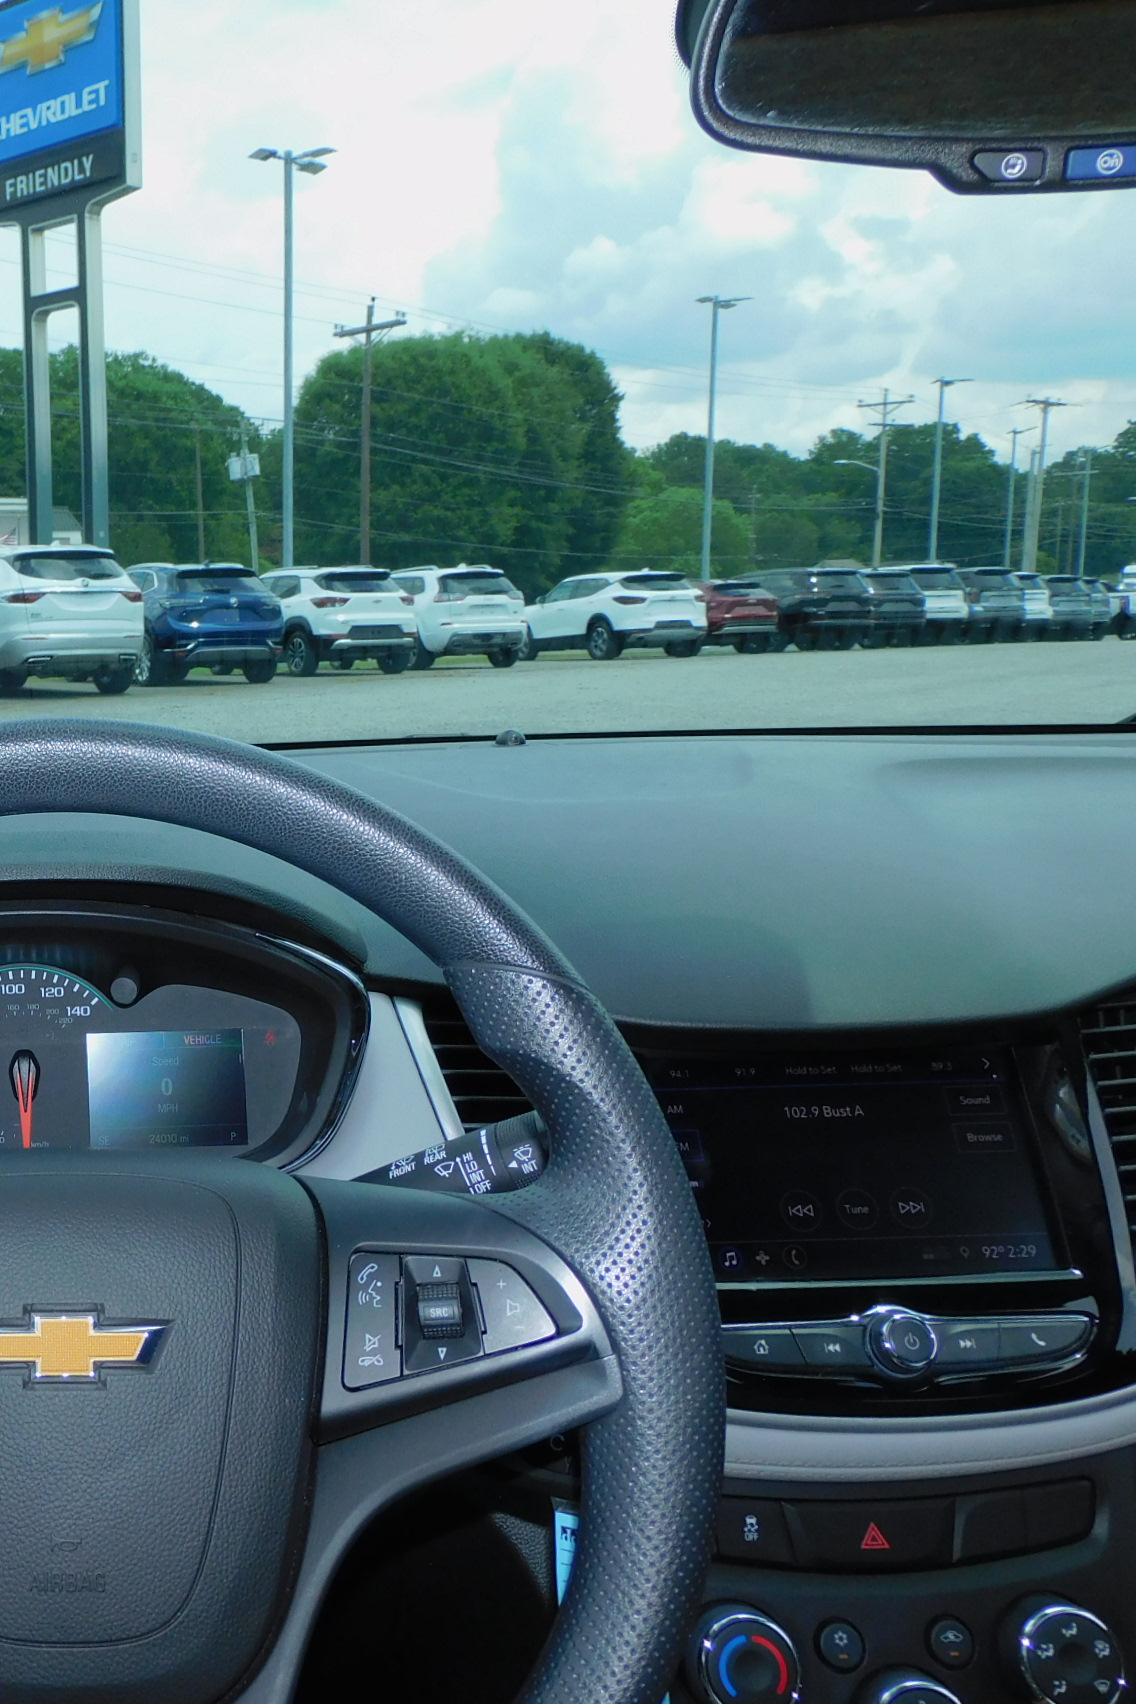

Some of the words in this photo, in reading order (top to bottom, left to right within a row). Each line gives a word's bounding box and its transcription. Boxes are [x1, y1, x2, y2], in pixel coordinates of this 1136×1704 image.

[5, 154, 94, 201] FRIENDLY
[0, 984, 25, 994] 100
[40, 987, 64, 998] 120
[66, 1006, 91, 1017] 140
[183, 1034, 222, 1046] VEHICLE
[152, 1056, 179, 1067] Speed
[785, 1066, 807, 1076] Hold
[809, 1067, 819, 1075] to
[820, 1065, 838, 1074] Set
[850, 1064, 872, 1073] Hold
[874, 1064, 884, 1072] to
[885, 1063, 903, 1072] Set
[161, 1078, 173, 1096] 0
[959, 1095, 991, 1105] Sound
[158, 1103, 179, 1114] MPH
[667, 1105, 684, 1115] AM
[783, 1106, 819, 1119] 102.9
[822, 1105, 852, 1118] Bust
[854, 1105, 865, 1117] A
[98, 1136, 110, 1146] SE
[149, 1133, 177, 1144] 24010
[230, 1132, 237, 1141] P
[966, 1132, 1004, 1143] Browse
[30, 1140, 50, 1148] km/h
[423, 1151, 447, 1166] REAR
[463, 1152, 473, 1163] HI
[389, 1162, 416, 1180] FRONT
[465, 1161, 478, 1173] LO
[521, 1160, 538, 1175] INT
[469, 1169, 485, 1183] INT
[475, 1180, 492, 1194] OFF
[843, 1204, 870, 1215] Tune
[1007, 1244, 1037, 1258] 2:29
[429, 1307, 449, 1318] SRC
[744, 1532, 759, 1542] OFF
[30, 1572, 106, 1593] AIRBAG
